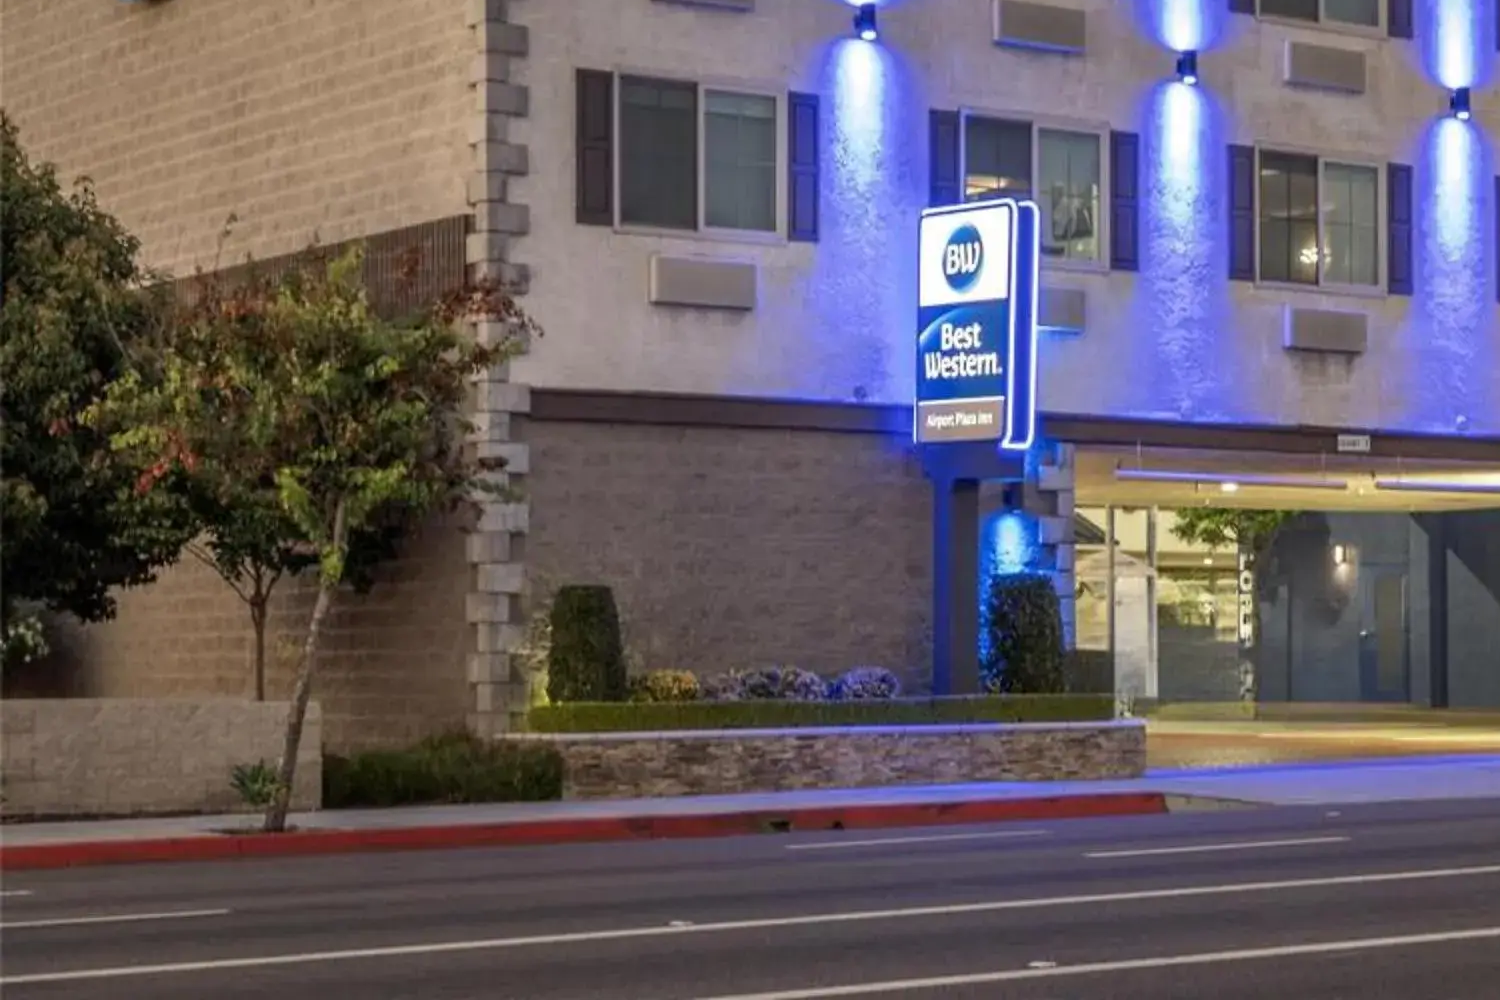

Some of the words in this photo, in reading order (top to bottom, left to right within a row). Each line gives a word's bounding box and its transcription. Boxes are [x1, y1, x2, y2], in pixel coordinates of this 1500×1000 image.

[945, 241, 981, 276] BW
[940, 322, 982, 352] Best
[926, 413, 955, 430] Airport
[955, 411, 977, 426] Plaza
